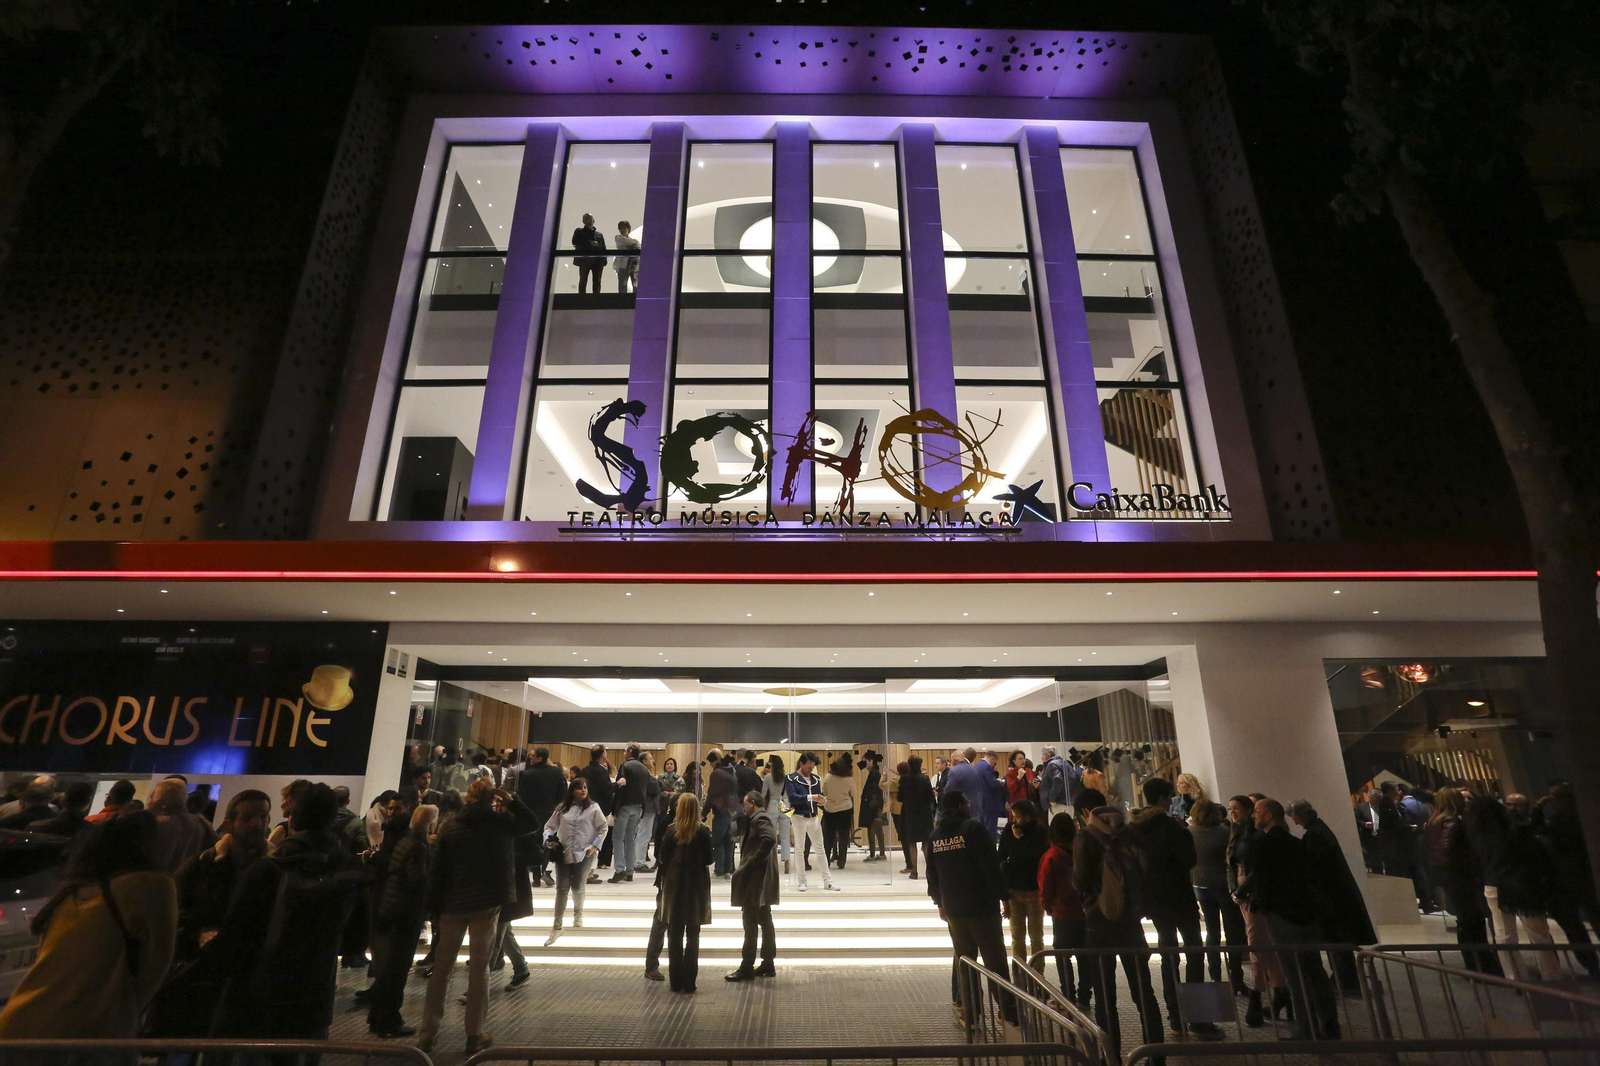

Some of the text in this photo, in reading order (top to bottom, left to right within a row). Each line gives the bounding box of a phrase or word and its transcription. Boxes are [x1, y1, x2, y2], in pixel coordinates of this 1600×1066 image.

[575, 398, 1005, 514] SOHO
[567, 507, 1005, 527] TEATRO MÚSICA DANZA MÁLAGA
[1067, 482, 1231, 513] CaixaBank
[0, 695, 331, 747] CHORUS LINE
